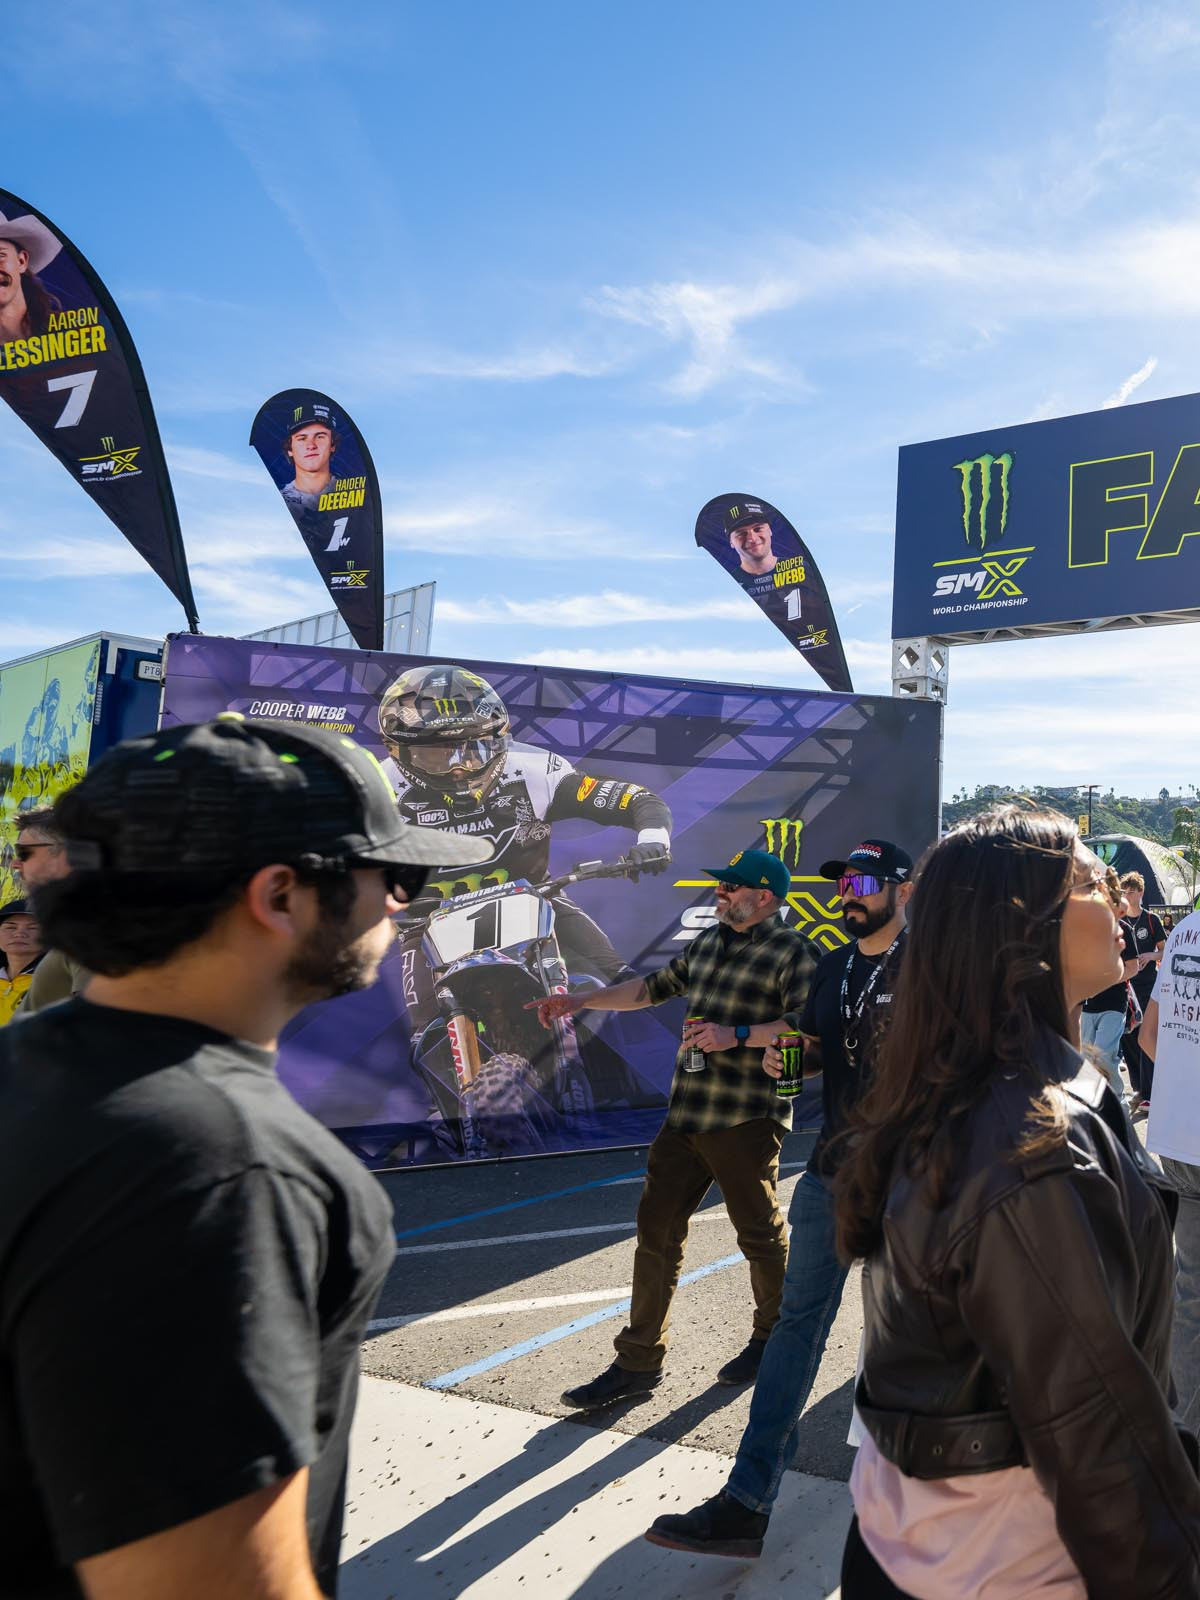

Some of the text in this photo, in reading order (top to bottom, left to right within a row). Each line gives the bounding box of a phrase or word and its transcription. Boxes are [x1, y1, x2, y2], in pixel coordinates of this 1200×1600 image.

[48, 307, 99, 332] AARON
[48, 370, 98, 429] 7
[81, 452, 139, 475] SMX
[335, 476, 367, 492] HAIDEN
[318, 489, 366, 512] DEEGAN
[775, 556, 804, 573] COOPER
[330, 573, 368, 586] SMX
[773, 566, 806, 588] WEBB
[932, 556, 1029, 600] SMX
[783, 588, 801, 621] 1
[932, 598, 1028, 616] WORLD CHAMPIONSHIP
[799, 632, 828, 646] SMX
[249, 700, 347, 720] COOPER WEBB
[466, 898, 502, 952] 1
